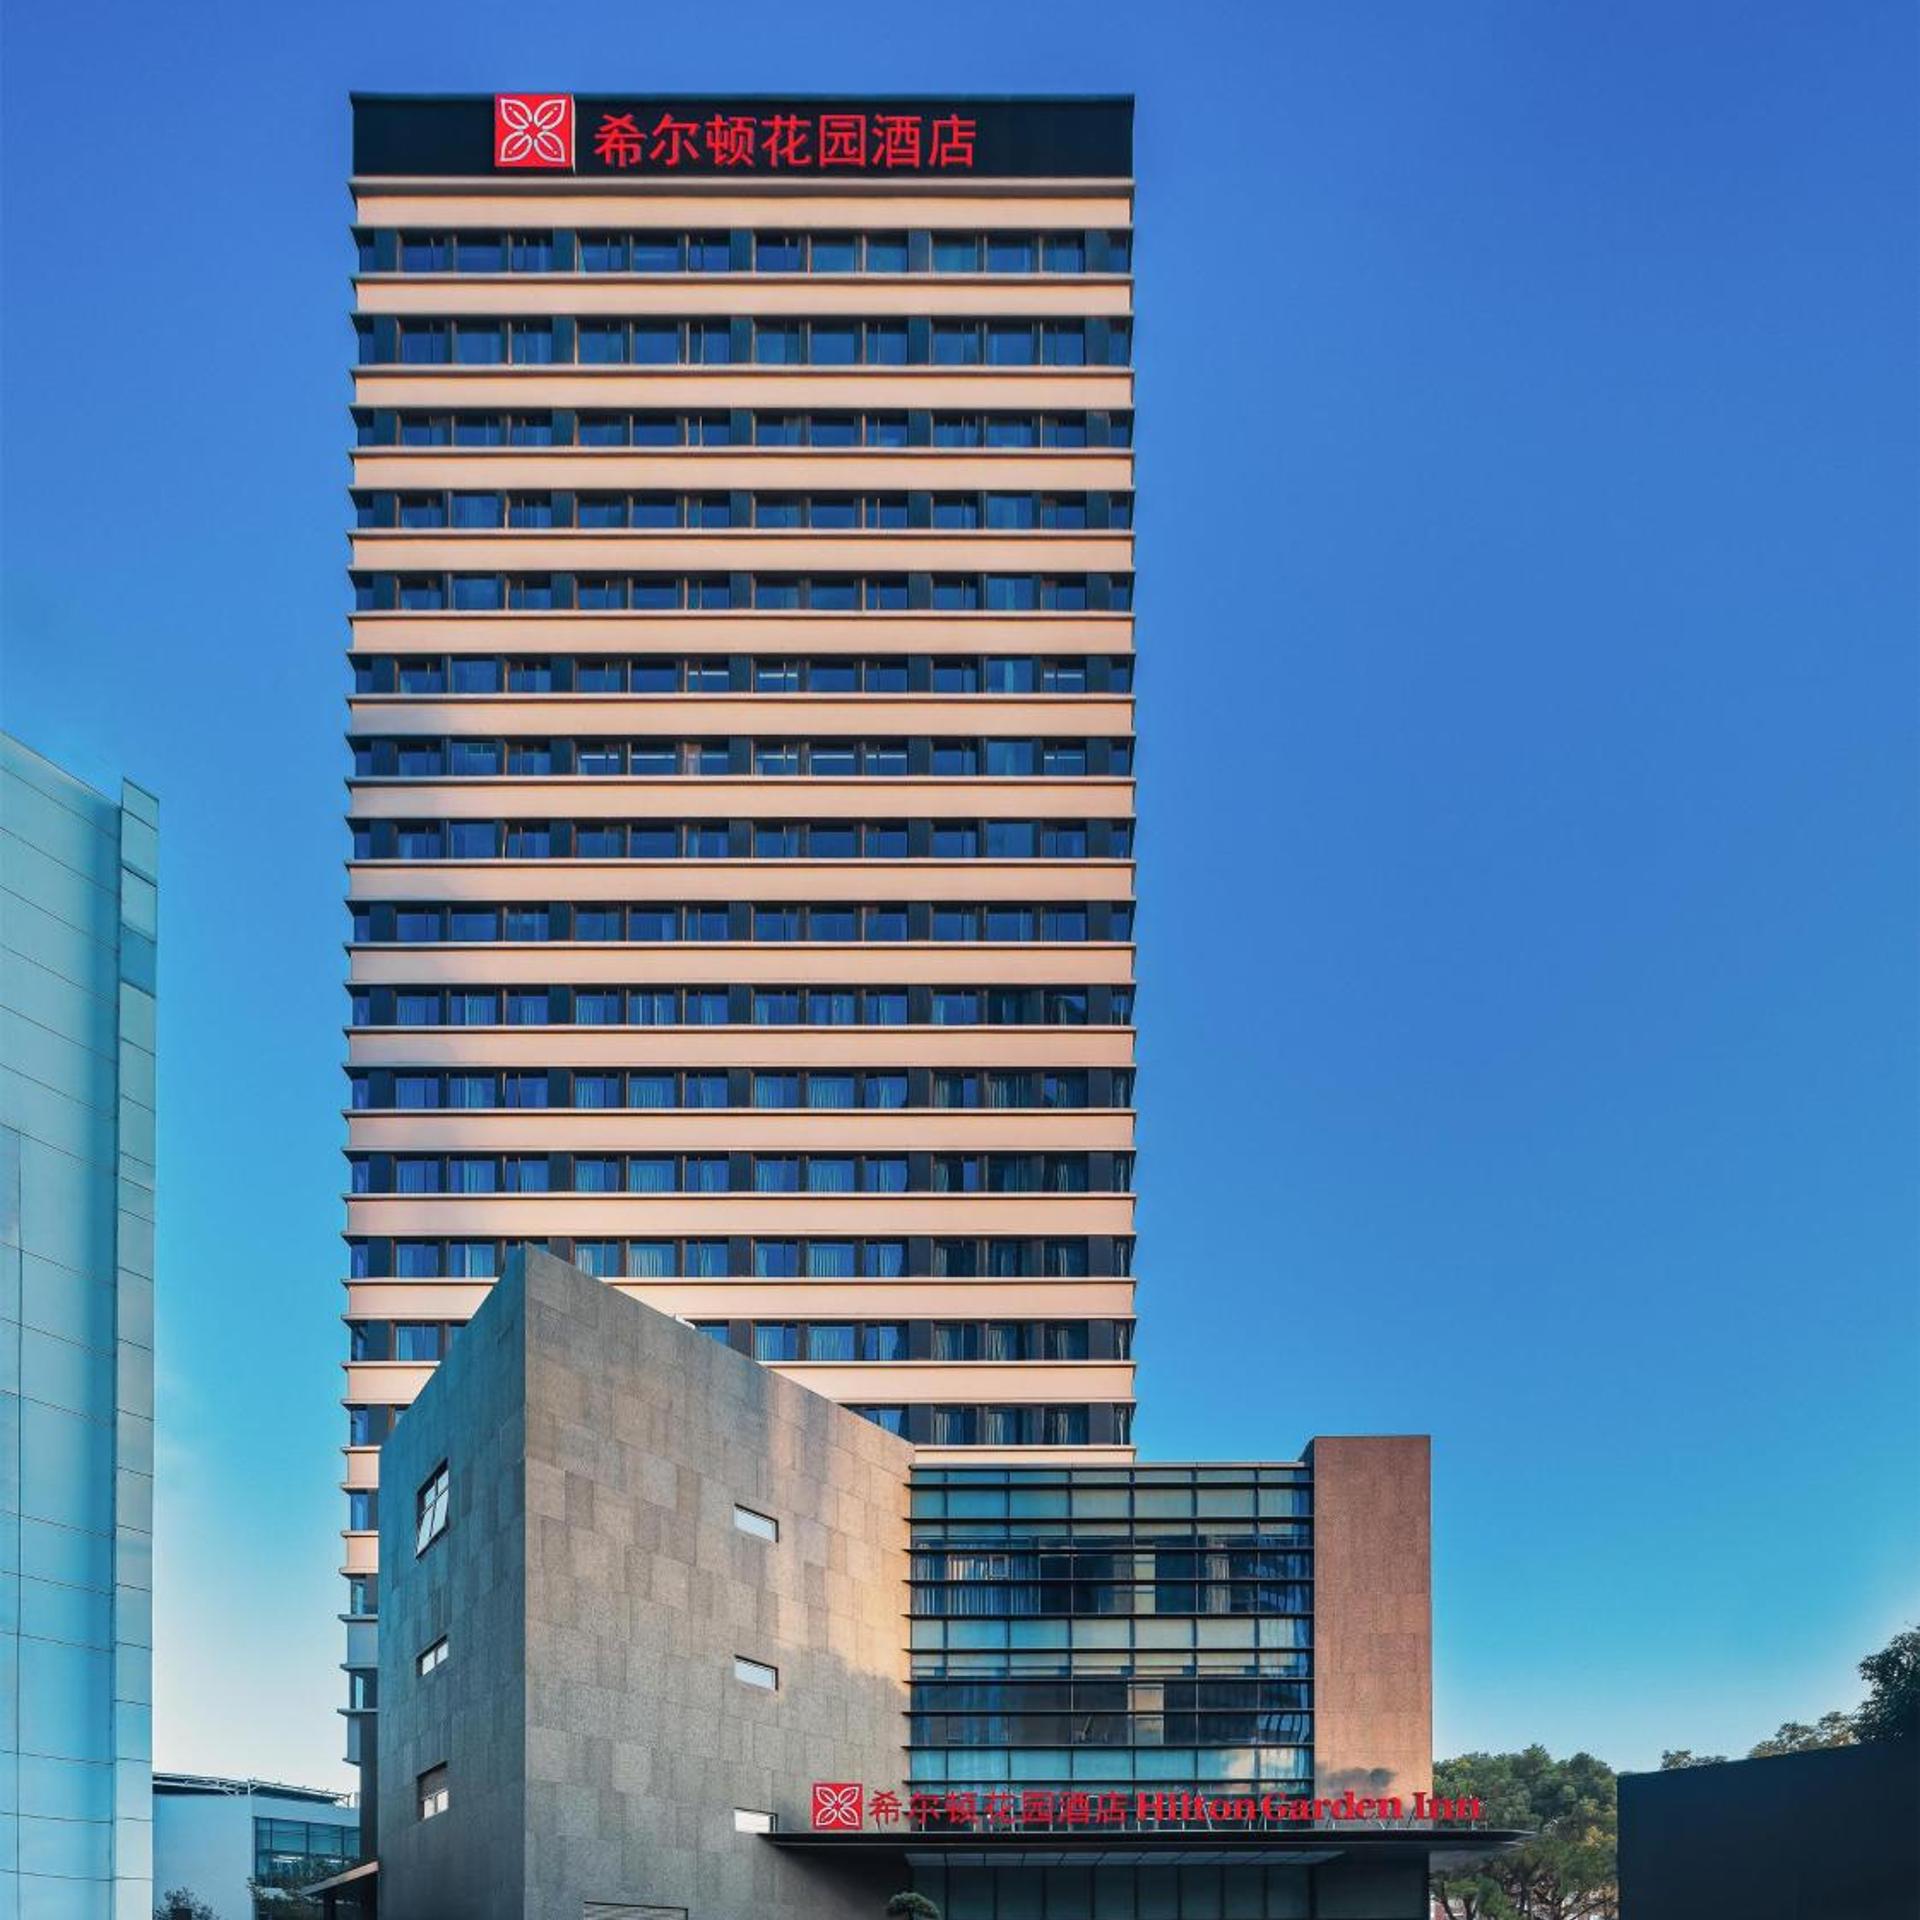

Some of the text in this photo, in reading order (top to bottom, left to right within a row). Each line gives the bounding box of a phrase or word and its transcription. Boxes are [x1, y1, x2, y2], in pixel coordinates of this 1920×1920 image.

[594, 113, 976, 168] 希尔顿花园酒店
[867, 1789, 1128, 1825] 希尔顿花园酒店
[1411, 1790, 1482, 1821] Inn
